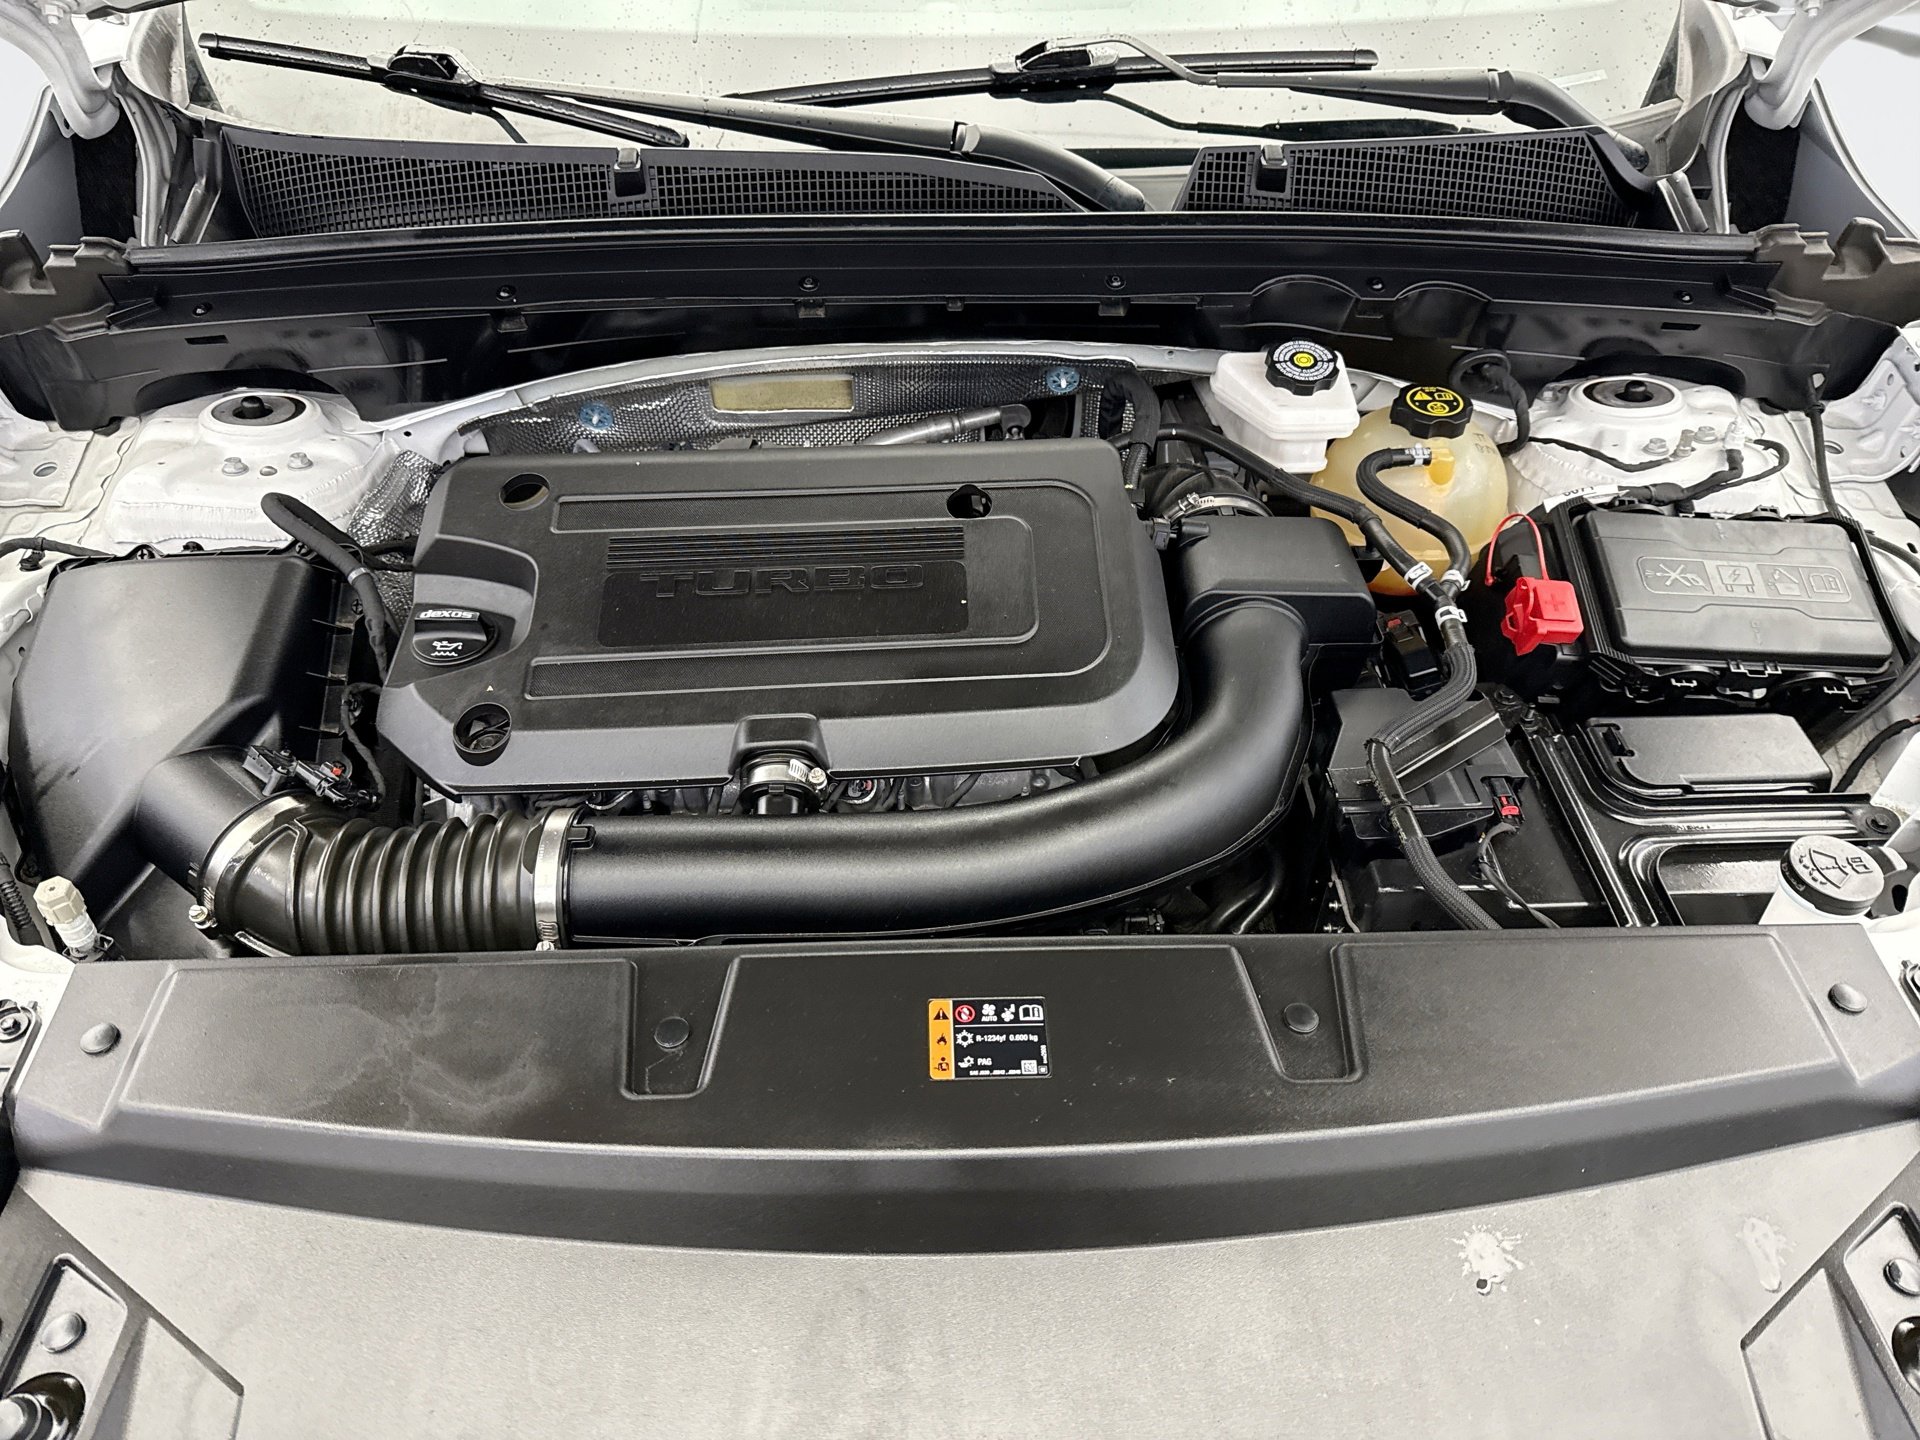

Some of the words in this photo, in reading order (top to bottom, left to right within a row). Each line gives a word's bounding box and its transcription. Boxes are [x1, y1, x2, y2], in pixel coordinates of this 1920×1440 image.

[640, 564, 924, 597] TURBO
[419, 609, 473, 619] dexos
[976, 1034, 1006, 1042] R-1234yf
[1029, 1034, 1039, 1042] kg
[977, 1057, 993, 1066] PAG
